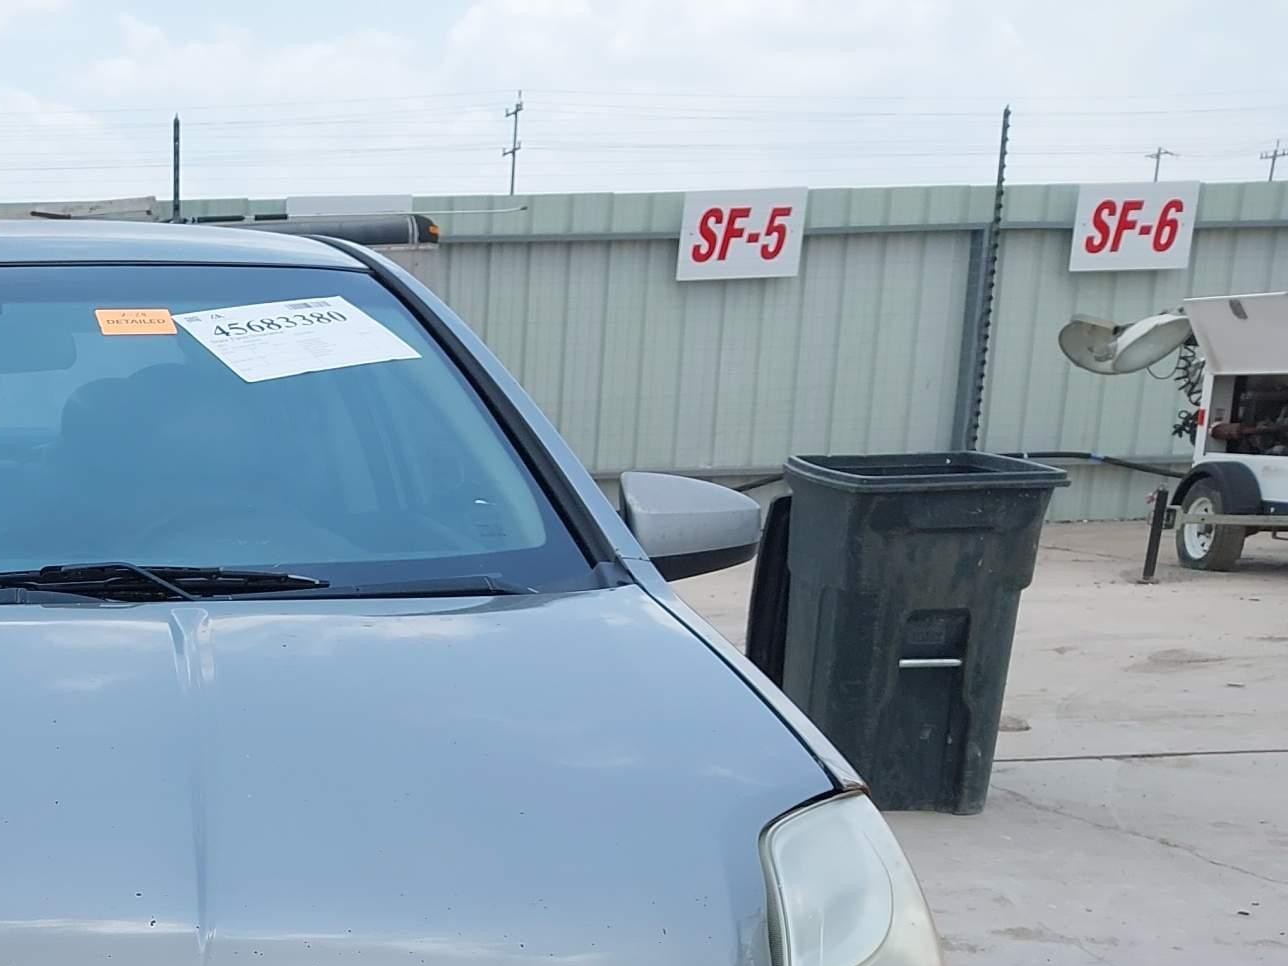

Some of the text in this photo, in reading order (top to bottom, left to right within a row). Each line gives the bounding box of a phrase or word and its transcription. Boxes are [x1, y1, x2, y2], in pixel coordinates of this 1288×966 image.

[691, 207, 792, 263] SF-5
[1085, 199, 1183, 254] SF-6
[106, 318, 166, 326] DETAILED
[214, 310, 347, 337] 45683380
